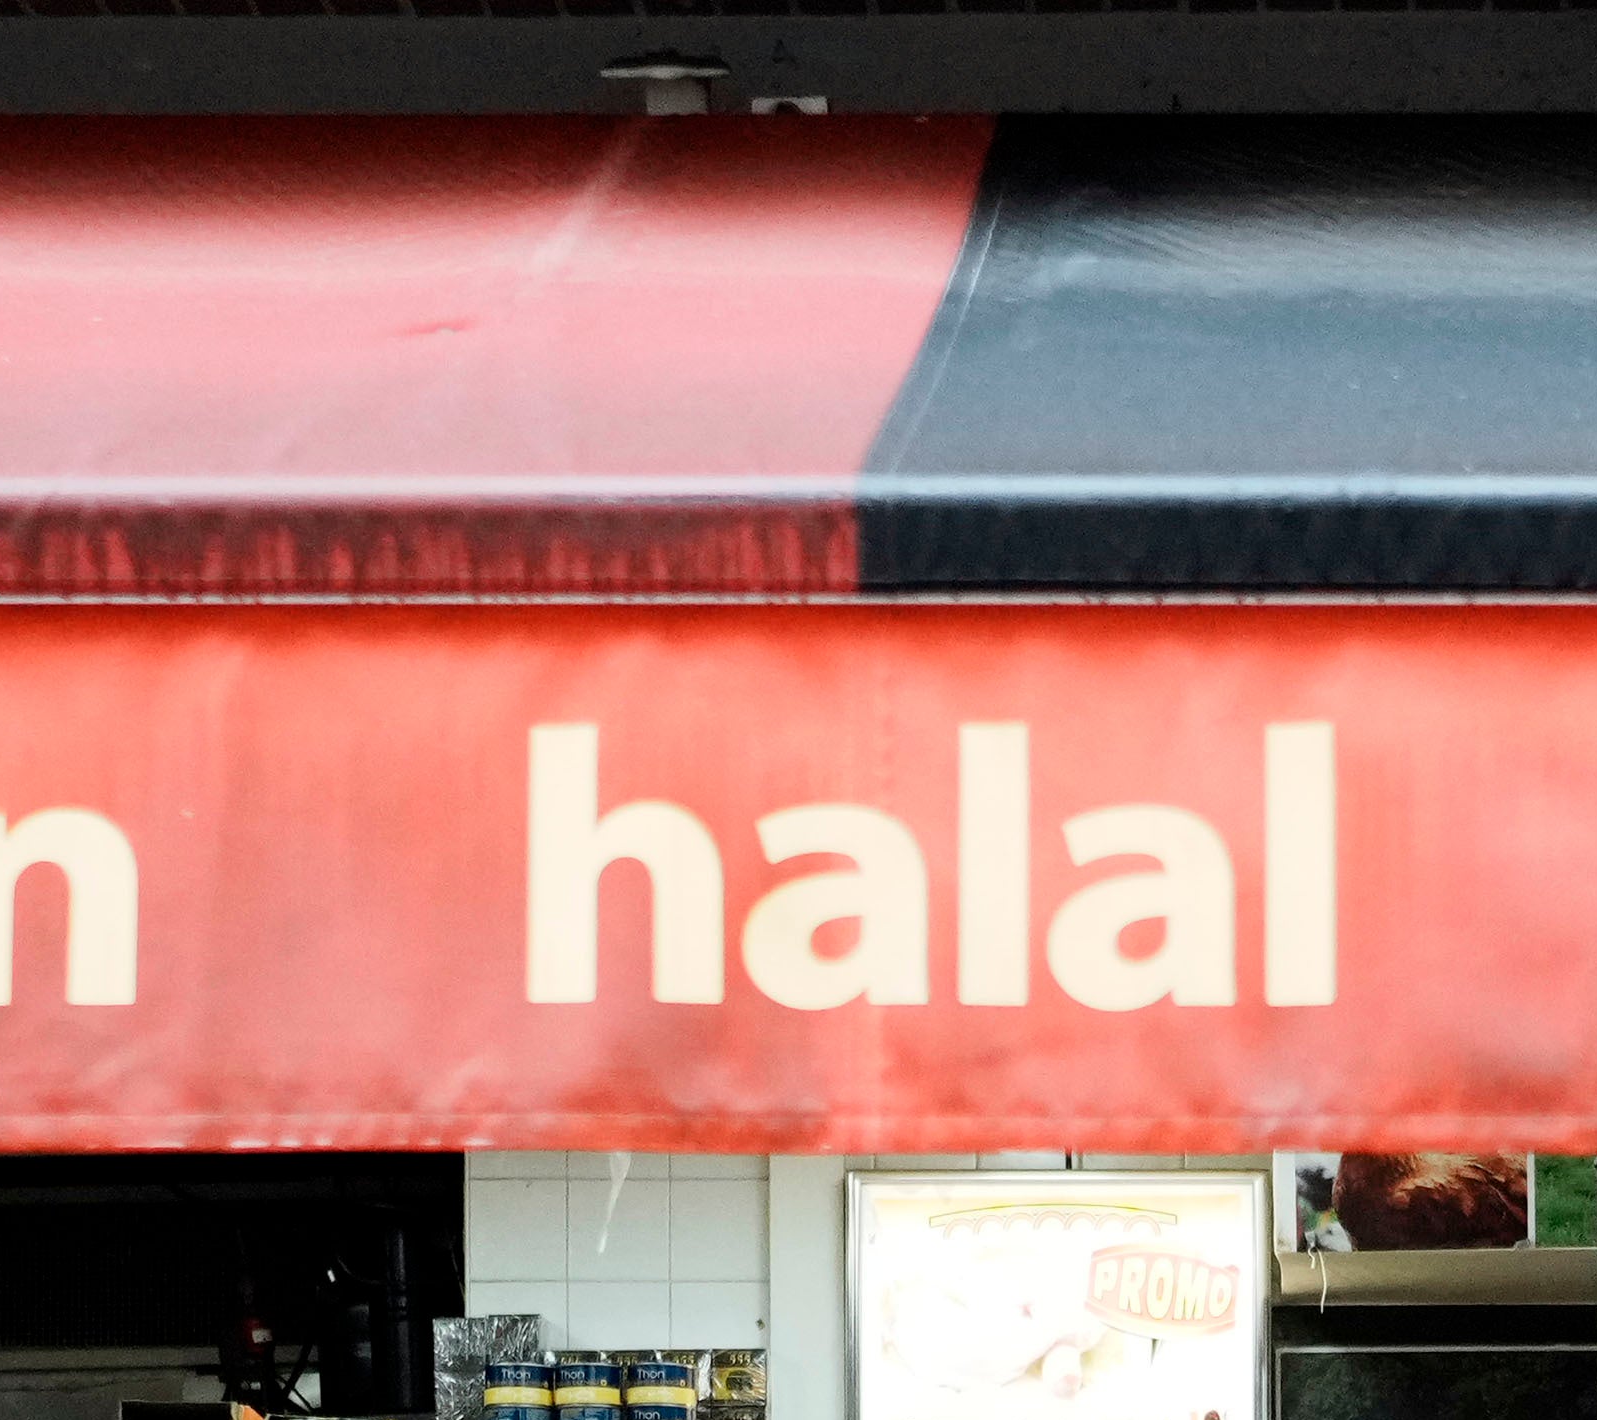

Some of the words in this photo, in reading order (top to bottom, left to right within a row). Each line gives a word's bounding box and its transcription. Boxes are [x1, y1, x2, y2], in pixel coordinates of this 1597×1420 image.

[528, 720, 1335, 1010] halal
[1093, 1257, 1232, 1321] PROMO
[502, 1367, 531, 1379] Thon
[636, 1367, 665, 1380] Thon
